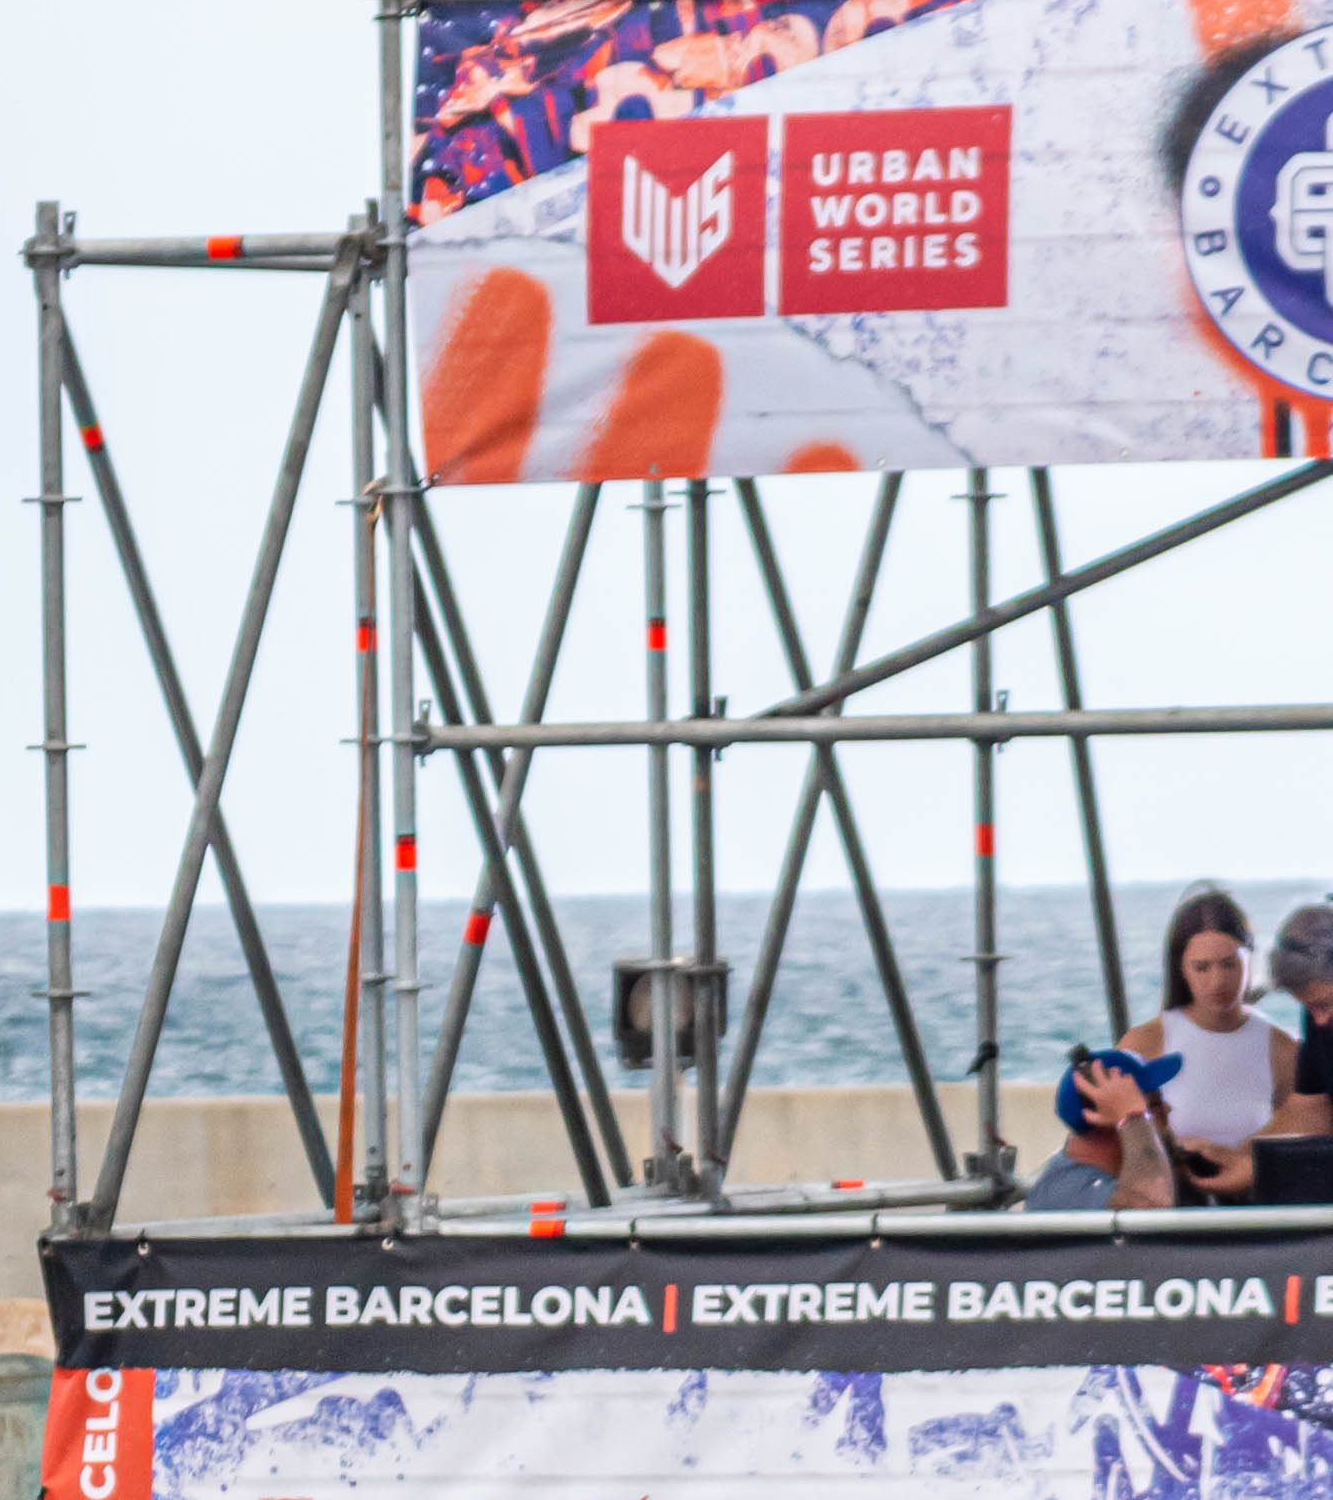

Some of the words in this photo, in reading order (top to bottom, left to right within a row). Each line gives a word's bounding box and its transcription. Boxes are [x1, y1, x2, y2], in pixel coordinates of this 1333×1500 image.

[811, 146, 981, 187] URBAN
[810, 189, 981, 229] WORLD
[809, 232, 981, 274] SERIES
[84, 1285, 312, 1331] EXTREME
[325, 1284, 651, 1328] BARCELONA
[691, 1282, 935, 1324] EXTREME
[947, 1277, 1275, 1321] BARCELONA
